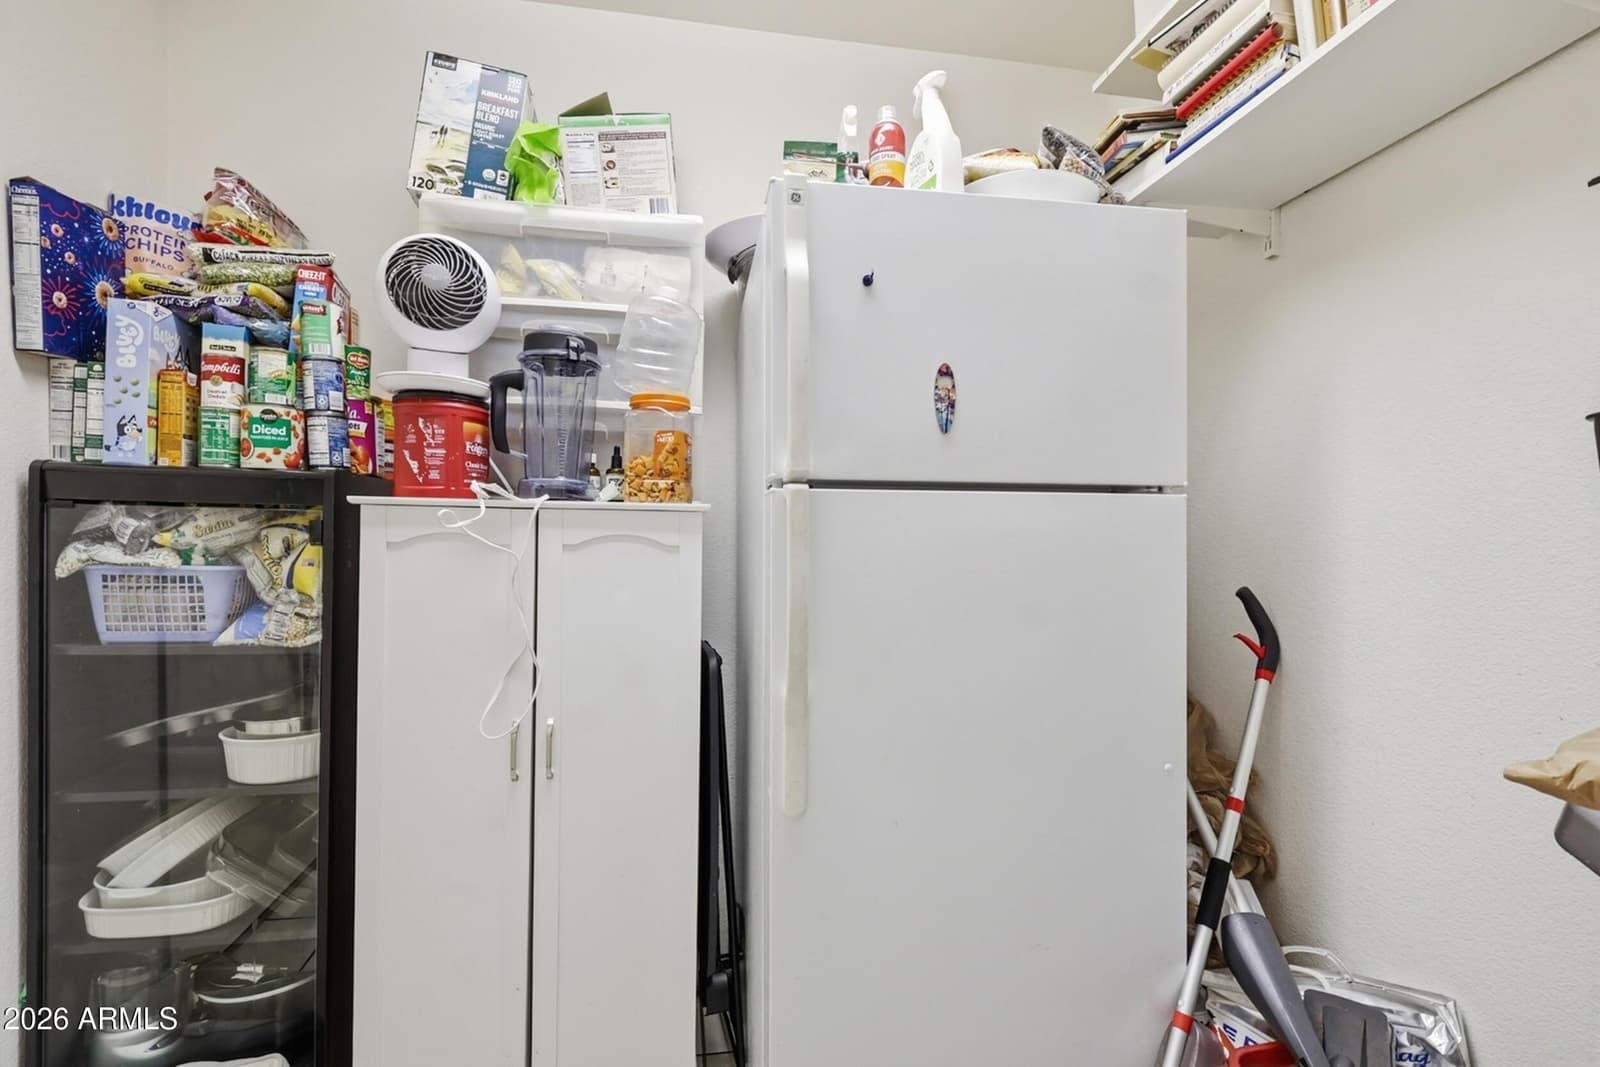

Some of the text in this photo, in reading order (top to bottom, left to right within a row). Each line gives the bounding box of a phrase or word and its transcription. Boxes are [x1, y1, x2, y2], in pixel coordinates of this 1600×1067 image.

[481, 89, 520, 104] KIRKLAND
[475, 111, 500, 125] BLEND
[477, 102, 521, 120] BREAKFAST
[412, 176, 435, 191] 120
[126, 236, 185, 263] CHIPS
[133, 255, 175, 271] BUFFALO
[252, 424, 287, 436] Diced
